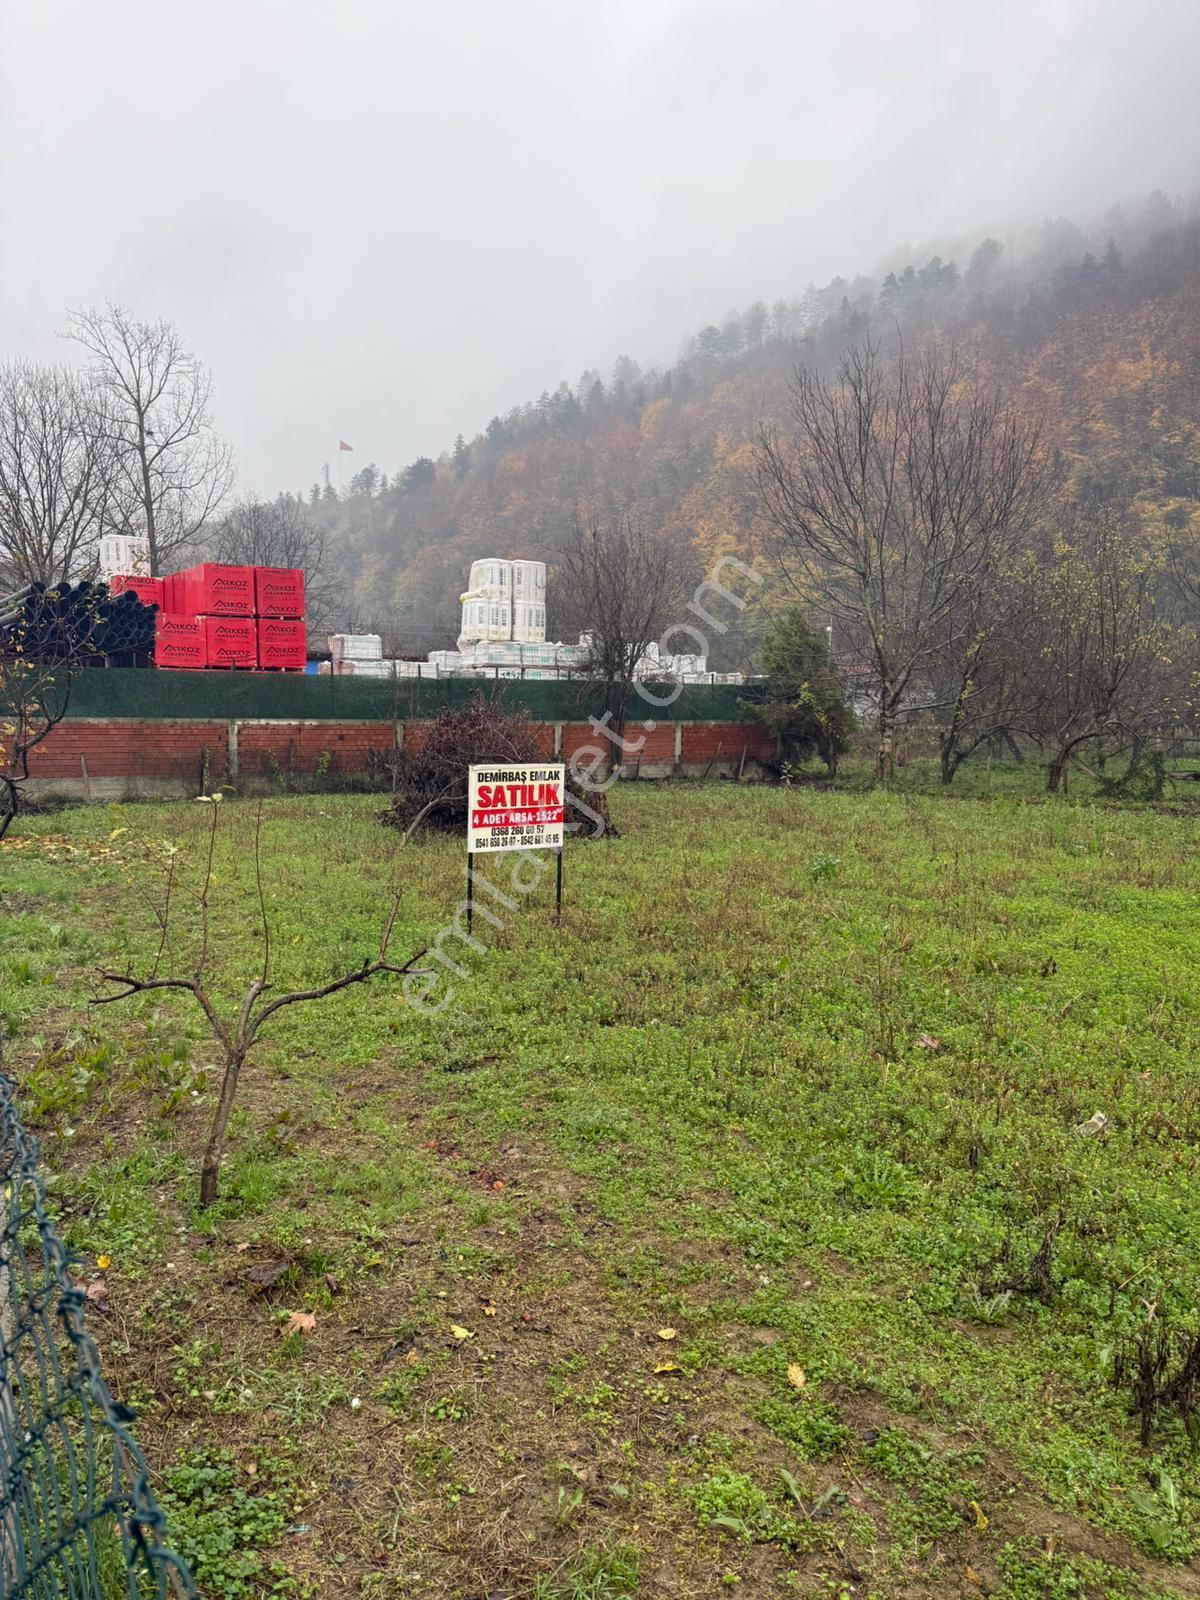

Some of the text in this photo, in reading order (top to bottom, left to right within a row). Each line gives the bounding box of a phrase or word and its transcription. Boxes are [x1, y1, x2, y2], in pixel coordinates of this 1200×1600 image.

[212, 577, 248, 587] ARKOZ
[263, 583, 297, 592] ARKOZ
[213, 599, 249, 609] ARKOZ
[265, 604, 298, 613] ARKOZ
[162, 621, 199, 631] ARKOZ
[215, 625, 250, 634] ARKOZ
[264, 624, 297, 633] ARKOZ
[163, 644, 200, 654] ARKOZ
[216, 647, 251, 656] ARKOZ
[265, 646, 300, 655] ARKOZ
[477, 769, 560, 784] DEMİRBAŞ EMLAK
[477, 783, 560, 808] SATILIK
[473, 814, 480, 824] 4
[483, 814, 506, 825] ADET
[491, 827, 509, 836] 0368
[536, 824, 545, 833] 57
